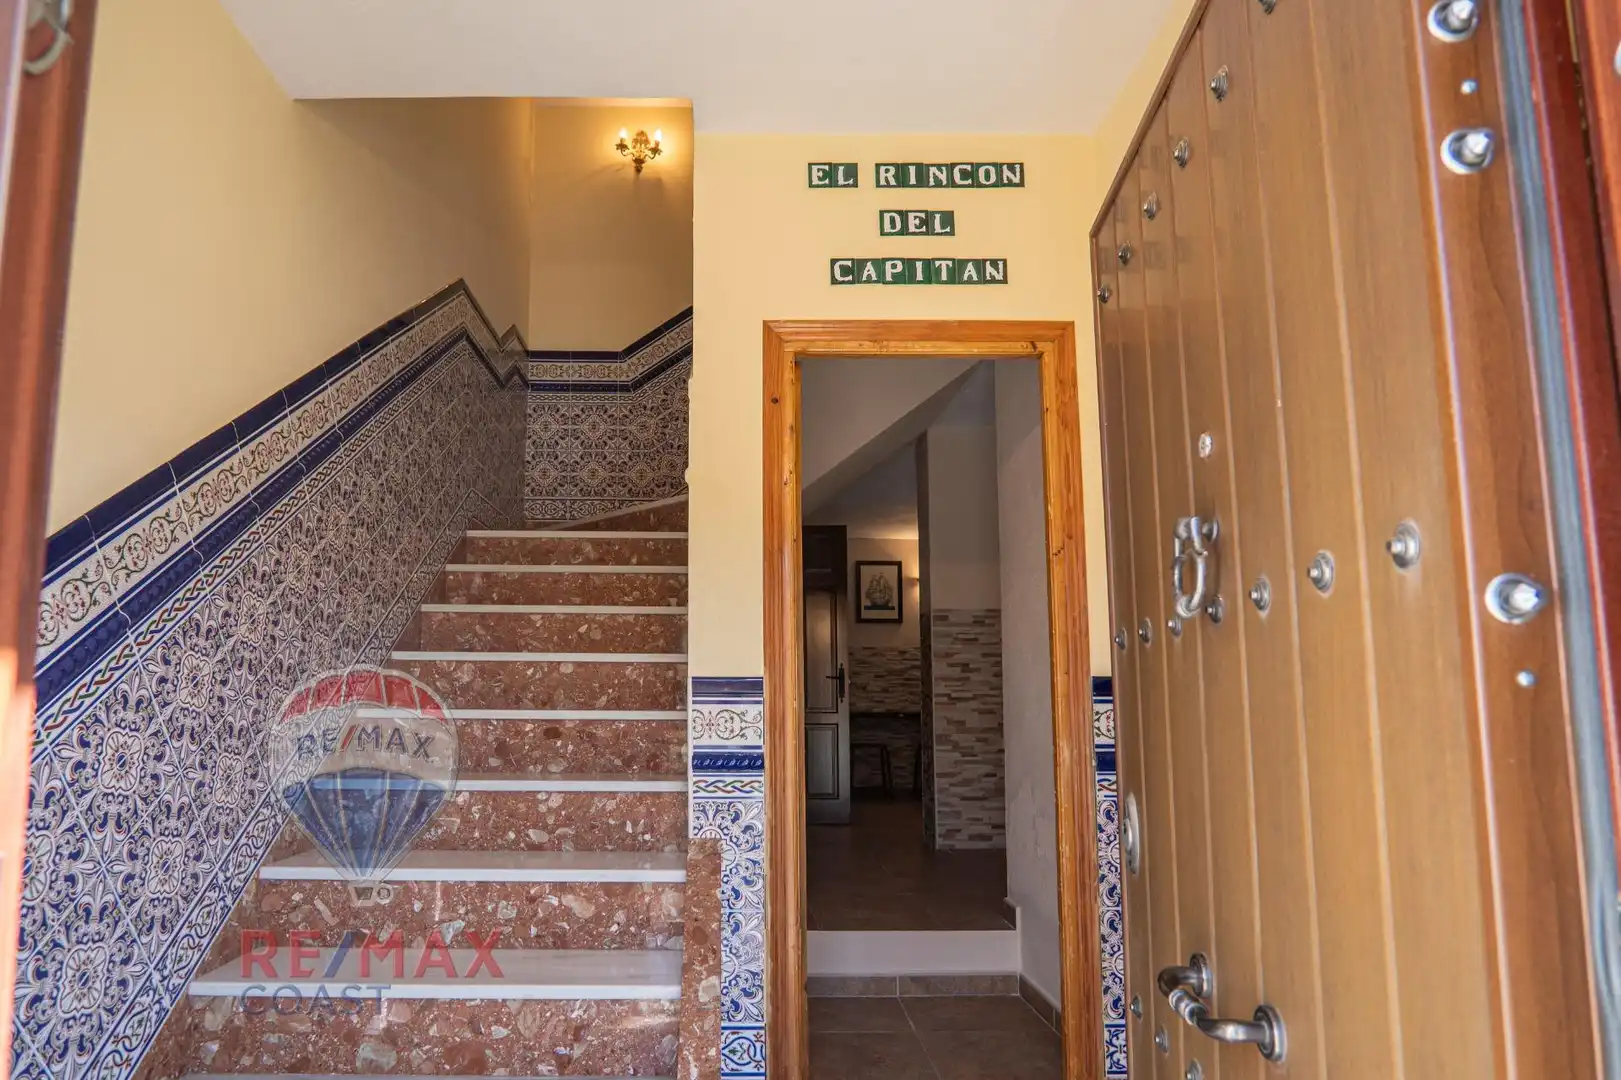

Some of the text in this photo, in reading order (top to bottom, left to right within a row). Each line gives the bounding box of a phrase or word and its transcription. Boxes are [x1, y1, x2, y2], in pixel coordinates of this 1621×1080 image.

[811, 164, 1021, 186] EL RINCON
[883, 212, 950, 233] DEL
[833, 260, 1004, 281] CAPITAN
